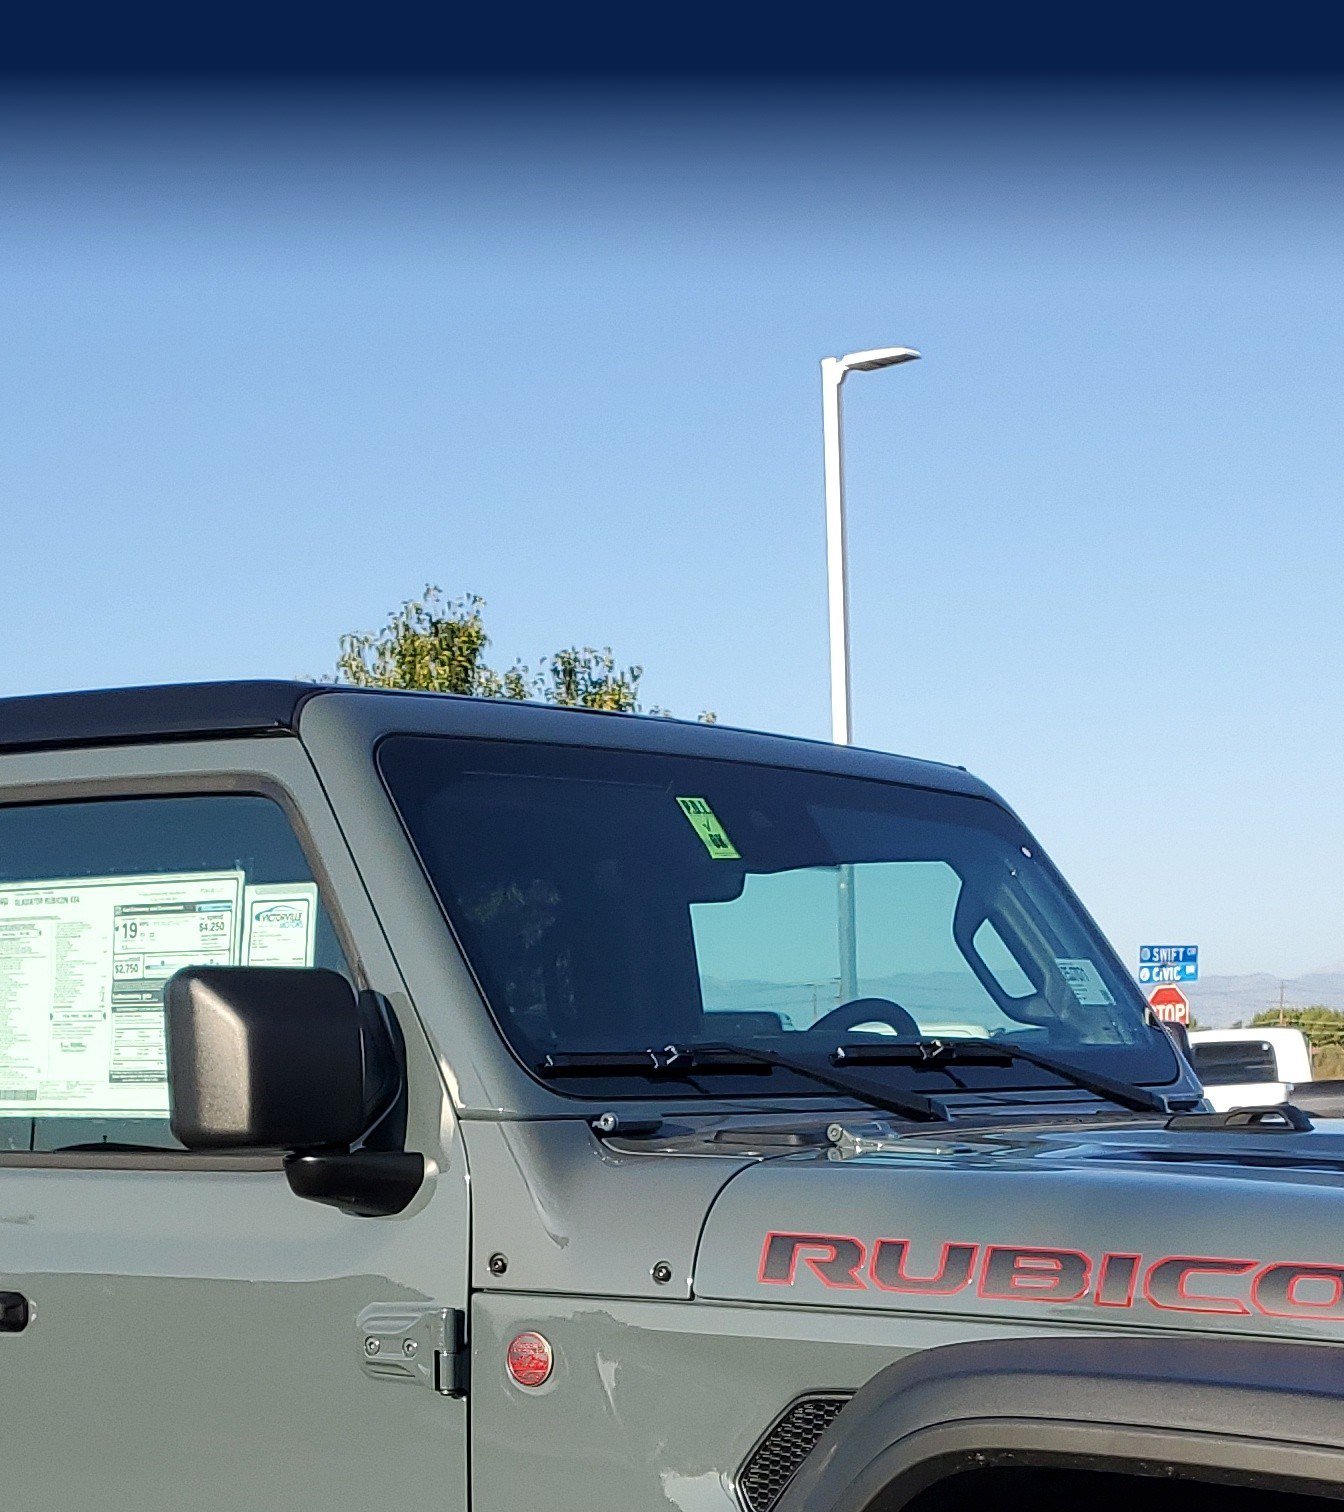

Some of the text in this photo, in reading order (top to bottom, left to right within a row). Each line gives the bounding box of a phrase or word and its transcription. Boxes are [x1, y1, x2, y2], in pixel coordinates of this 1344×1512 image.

[121, 921, 138, 939] 19
[1152, 948, 1186, 962] SWIFT
[1152, 965, 1182, 982] CIVIC
[1156, 1003, 1186, 1022] TOP
